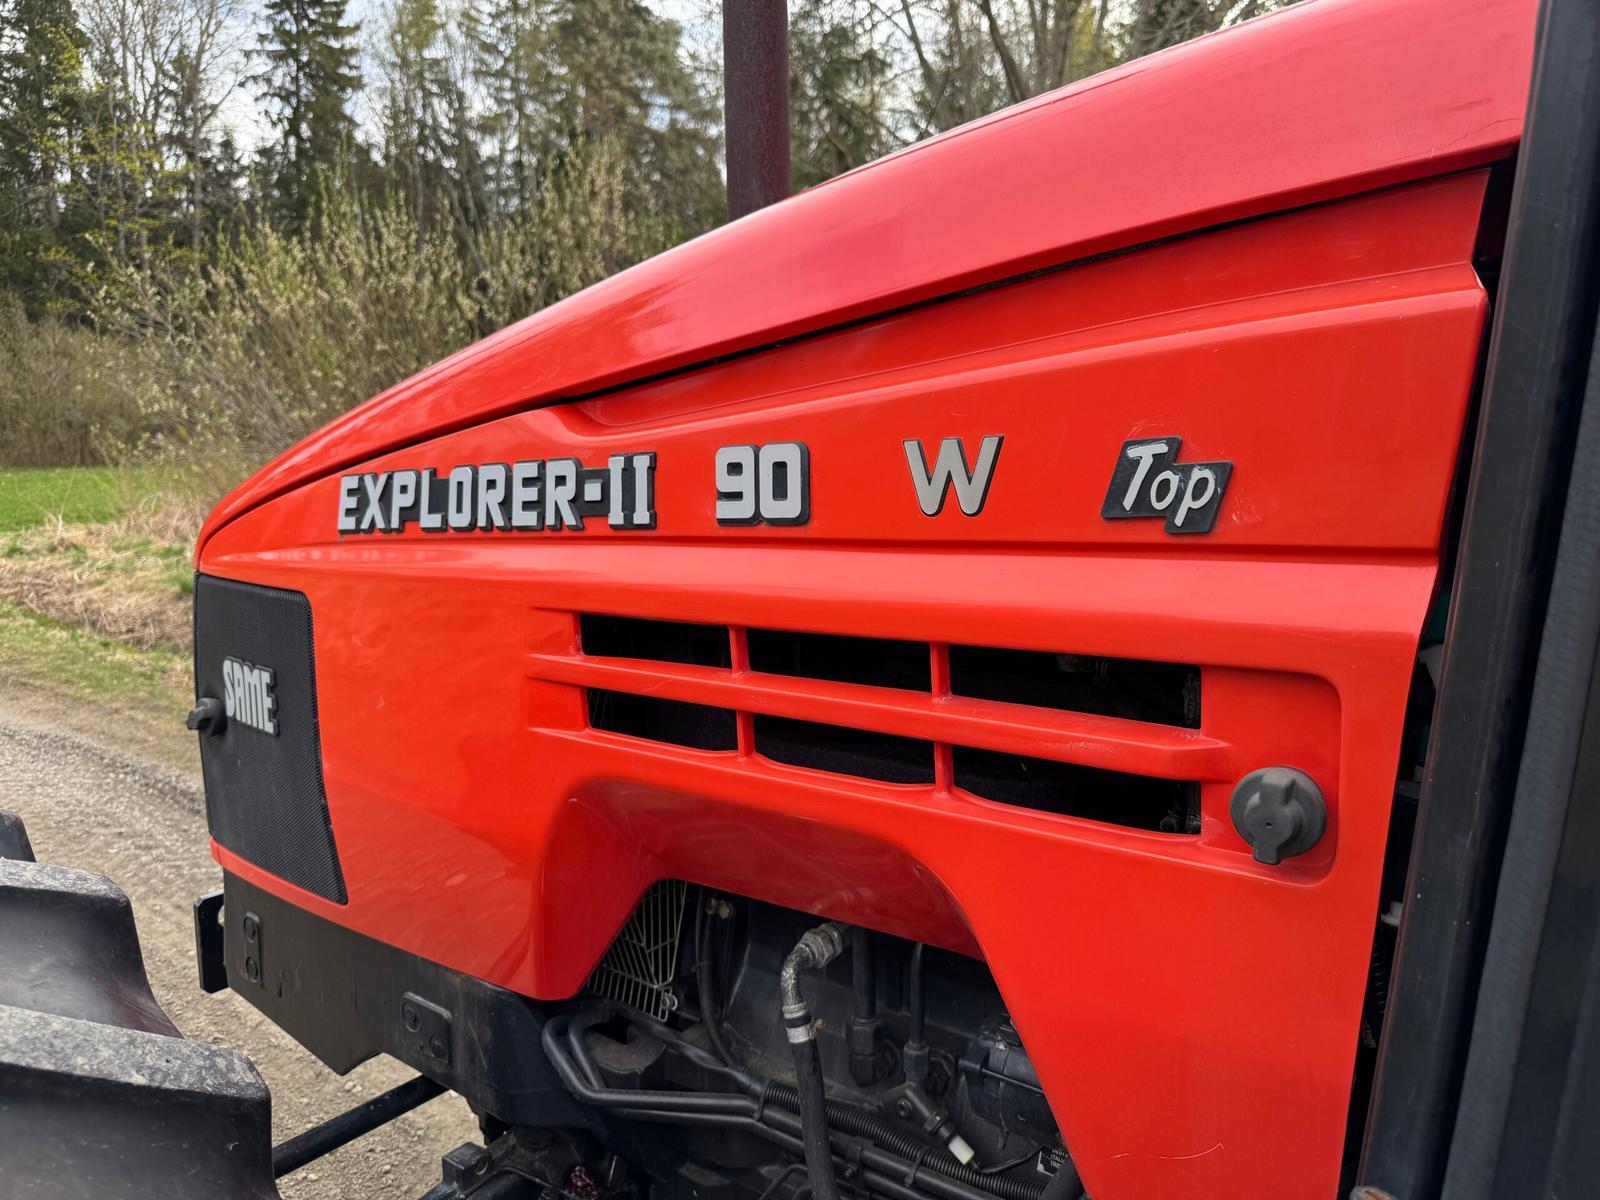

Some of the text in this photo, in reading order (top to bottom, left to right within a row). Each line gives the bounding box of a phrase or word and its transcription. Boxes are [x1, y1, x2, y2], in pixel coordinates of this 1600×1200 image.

[338, 436, 1216, 532] EXPLORER-II 90 W Top
[222, 658, 276, 735] SAME
